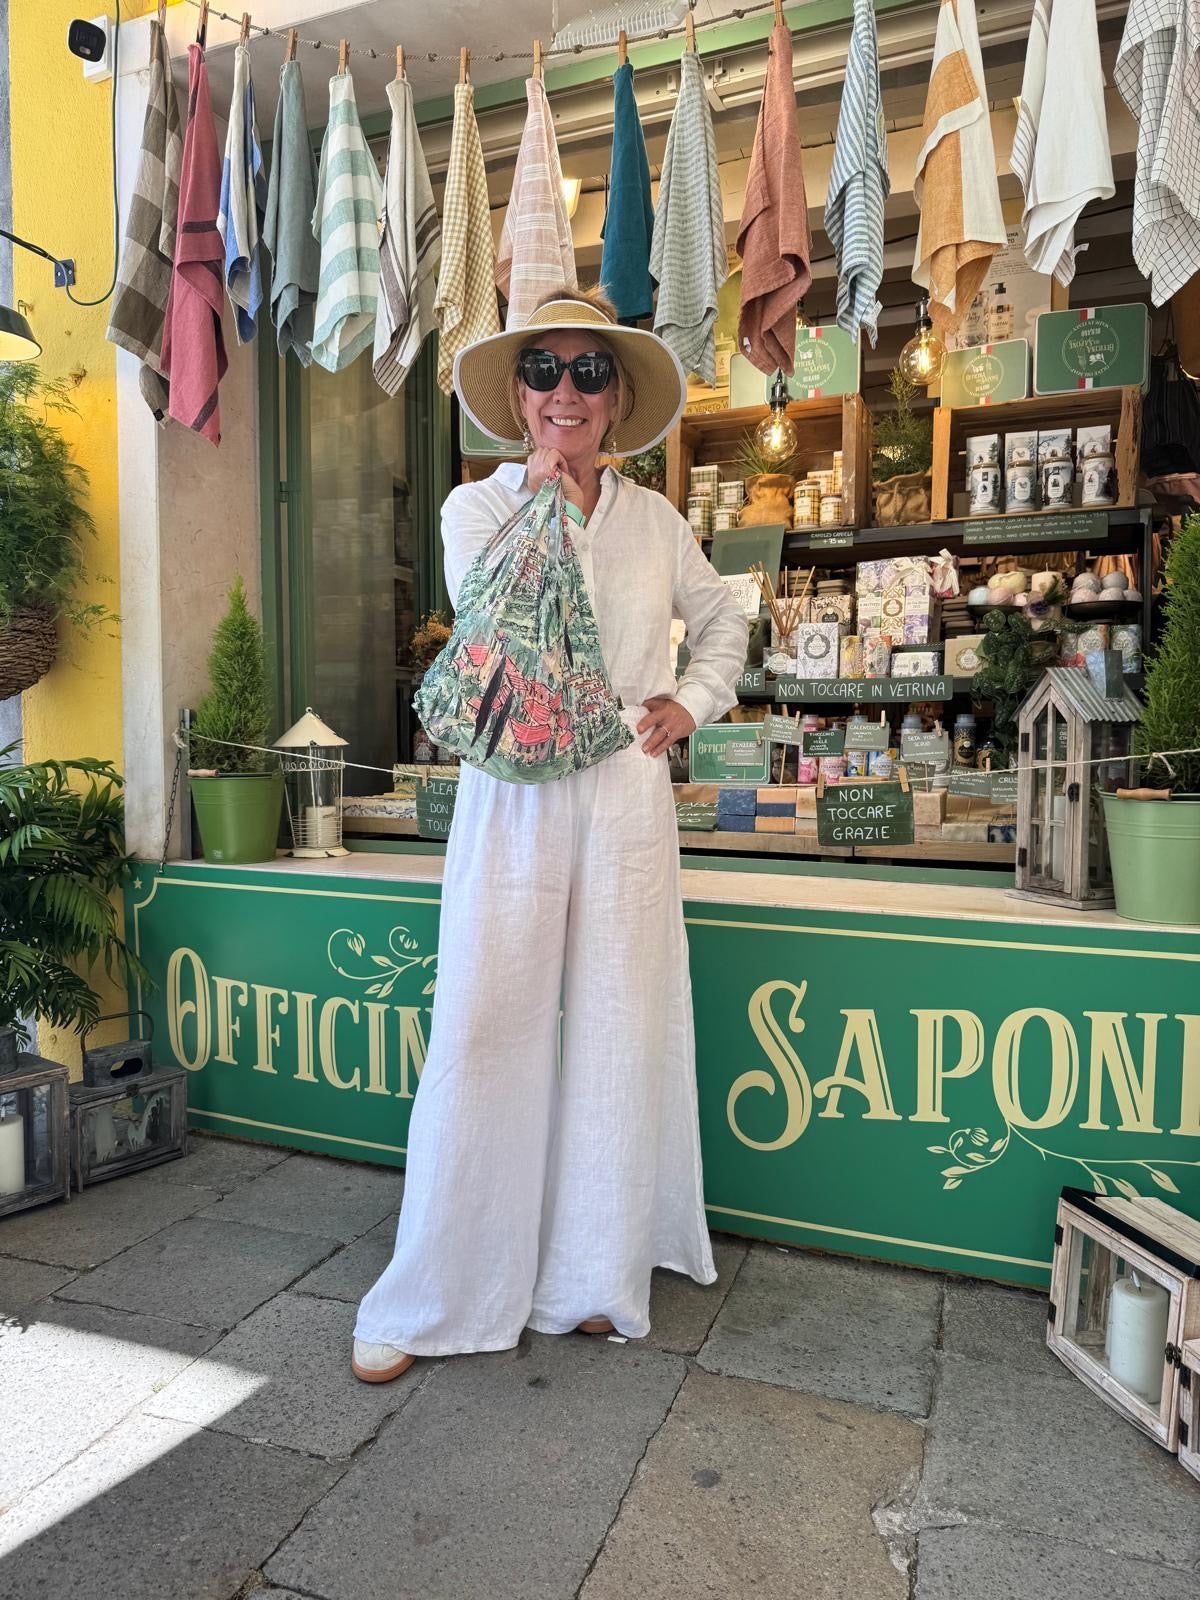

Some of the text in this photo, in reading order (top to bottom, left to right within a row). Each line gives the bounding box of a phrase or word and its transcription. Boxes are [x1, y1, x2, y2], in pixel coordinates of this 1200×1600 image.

[778, 681, 946, 698] NON TOCCARE IN VETRINA
[839, 788, 874, 802] NON
[430, 803, 456, 814] DON'
[826, 804, 897, 822] TOCCARE
[832, 825, 890, 840] GRAZIE
